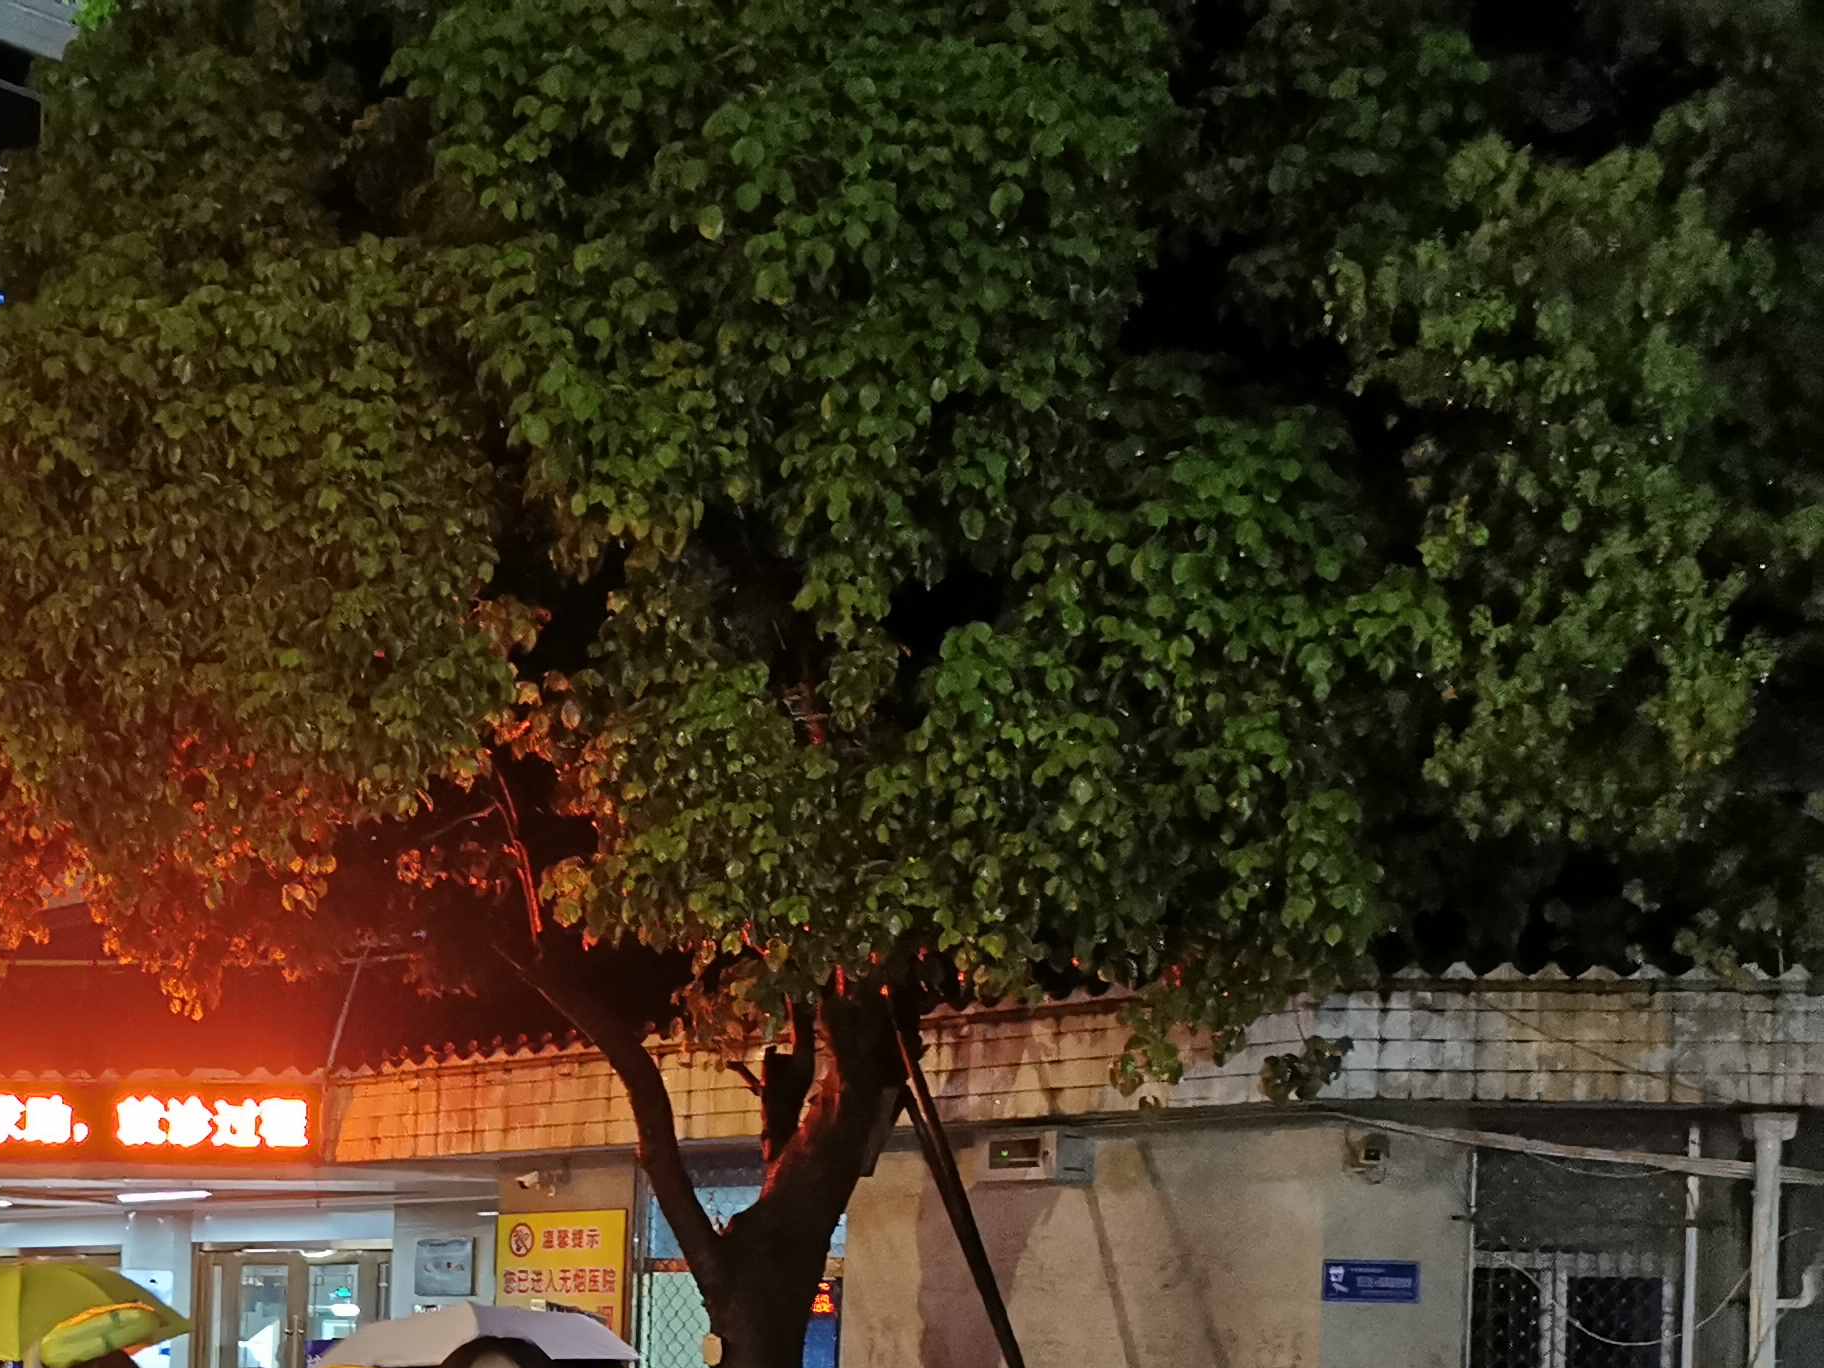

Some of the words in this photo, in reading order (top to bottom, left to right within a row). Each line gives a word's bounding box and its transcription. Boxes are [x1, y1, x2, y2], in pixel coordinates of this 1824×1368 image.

[542, 1228, 601, 1249] 温馨提示
[503, 1267, 616, 1295] 您已进入无烟医院
